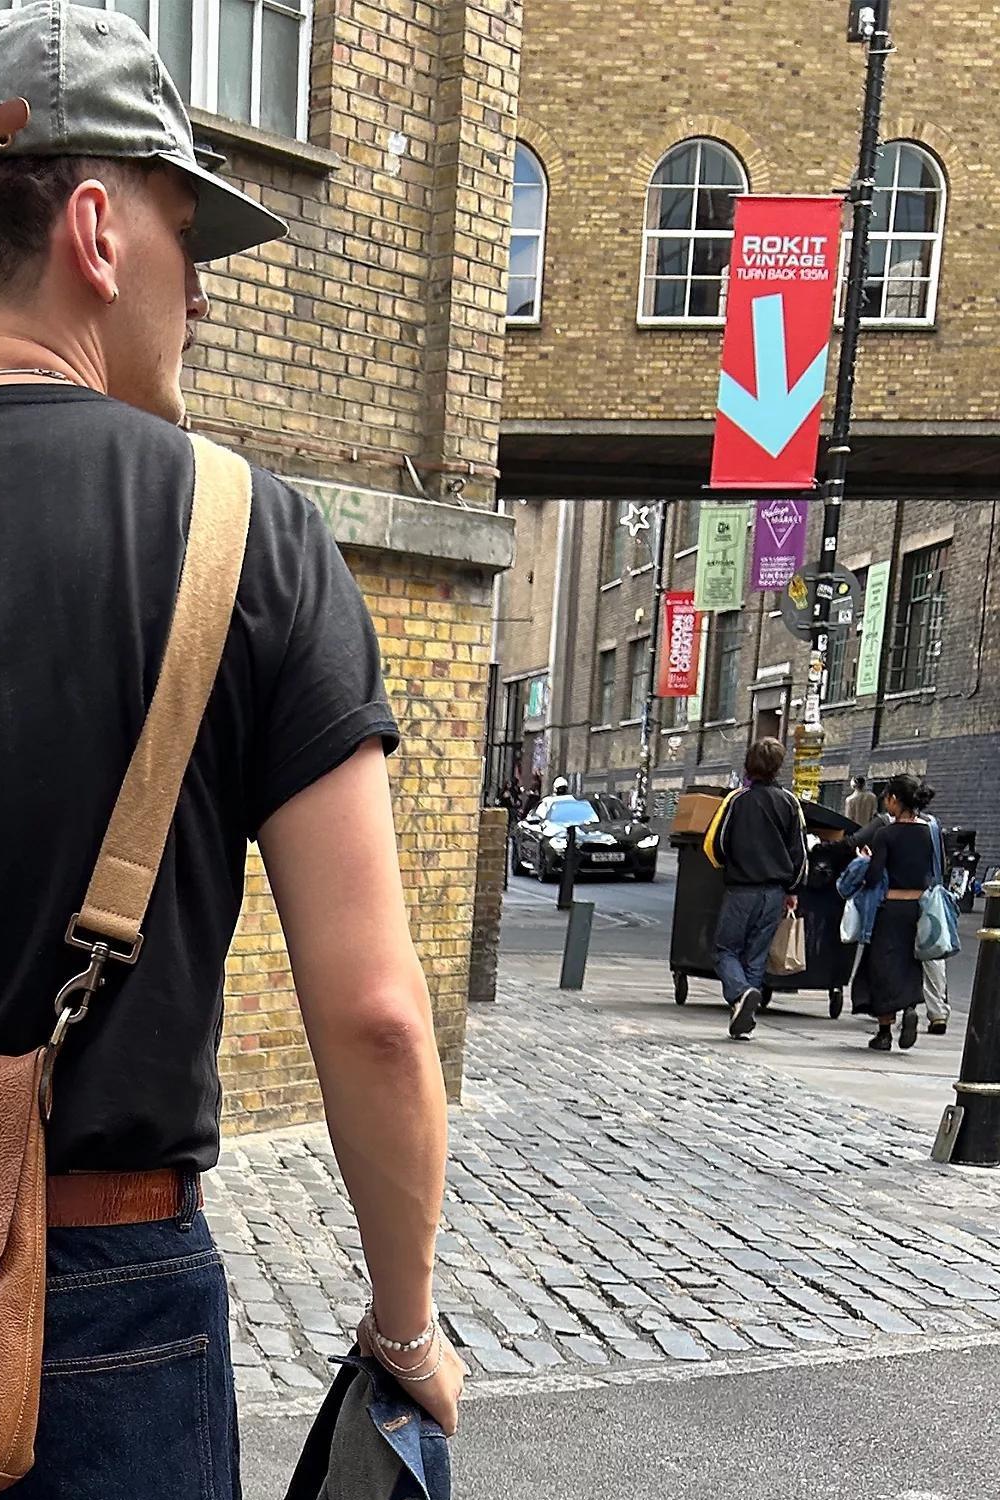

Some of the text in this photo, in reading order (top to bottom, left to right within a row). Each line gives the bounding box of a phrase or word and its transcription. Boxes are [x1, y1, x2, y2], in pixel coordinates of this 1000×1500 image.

[742, 235, 828, 254] ROKIT
[743, 254, 826, 267] VINTAGE
[737, 267, 766, 280] TURN
[767, 268, 797, 280] BACK
